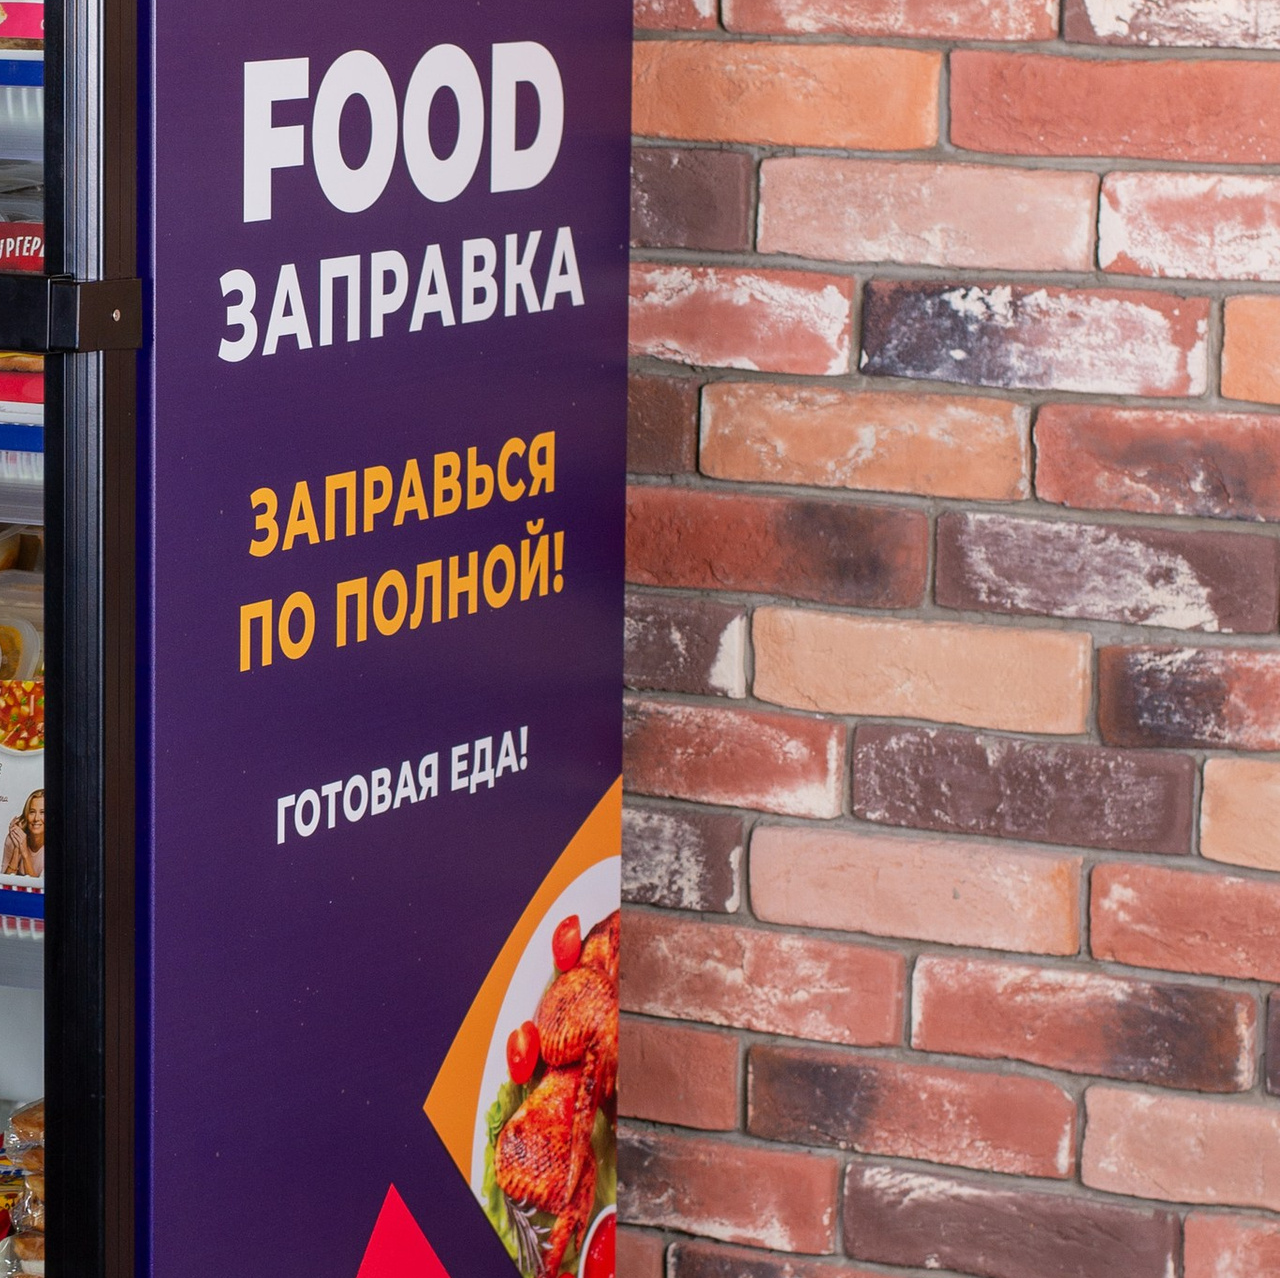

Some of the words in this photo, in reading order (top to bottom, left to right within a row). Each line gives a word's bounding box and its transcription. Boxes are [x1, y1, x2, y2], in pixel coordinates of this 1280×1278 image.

[243, 40, 565, 223] FOOD
[217, 226, 585, 363] ЗАПРАВКА
[248, 431, 556, 557] ЗАПРАВЬСЯ
[239, 592, 316, 673] ПО
[336, 519, 566, 648] ПОЛНОЙ!
[277, 752, 439, 845] ГОТОВАЯ
[450, 725, 529, 795] ЕДА!
